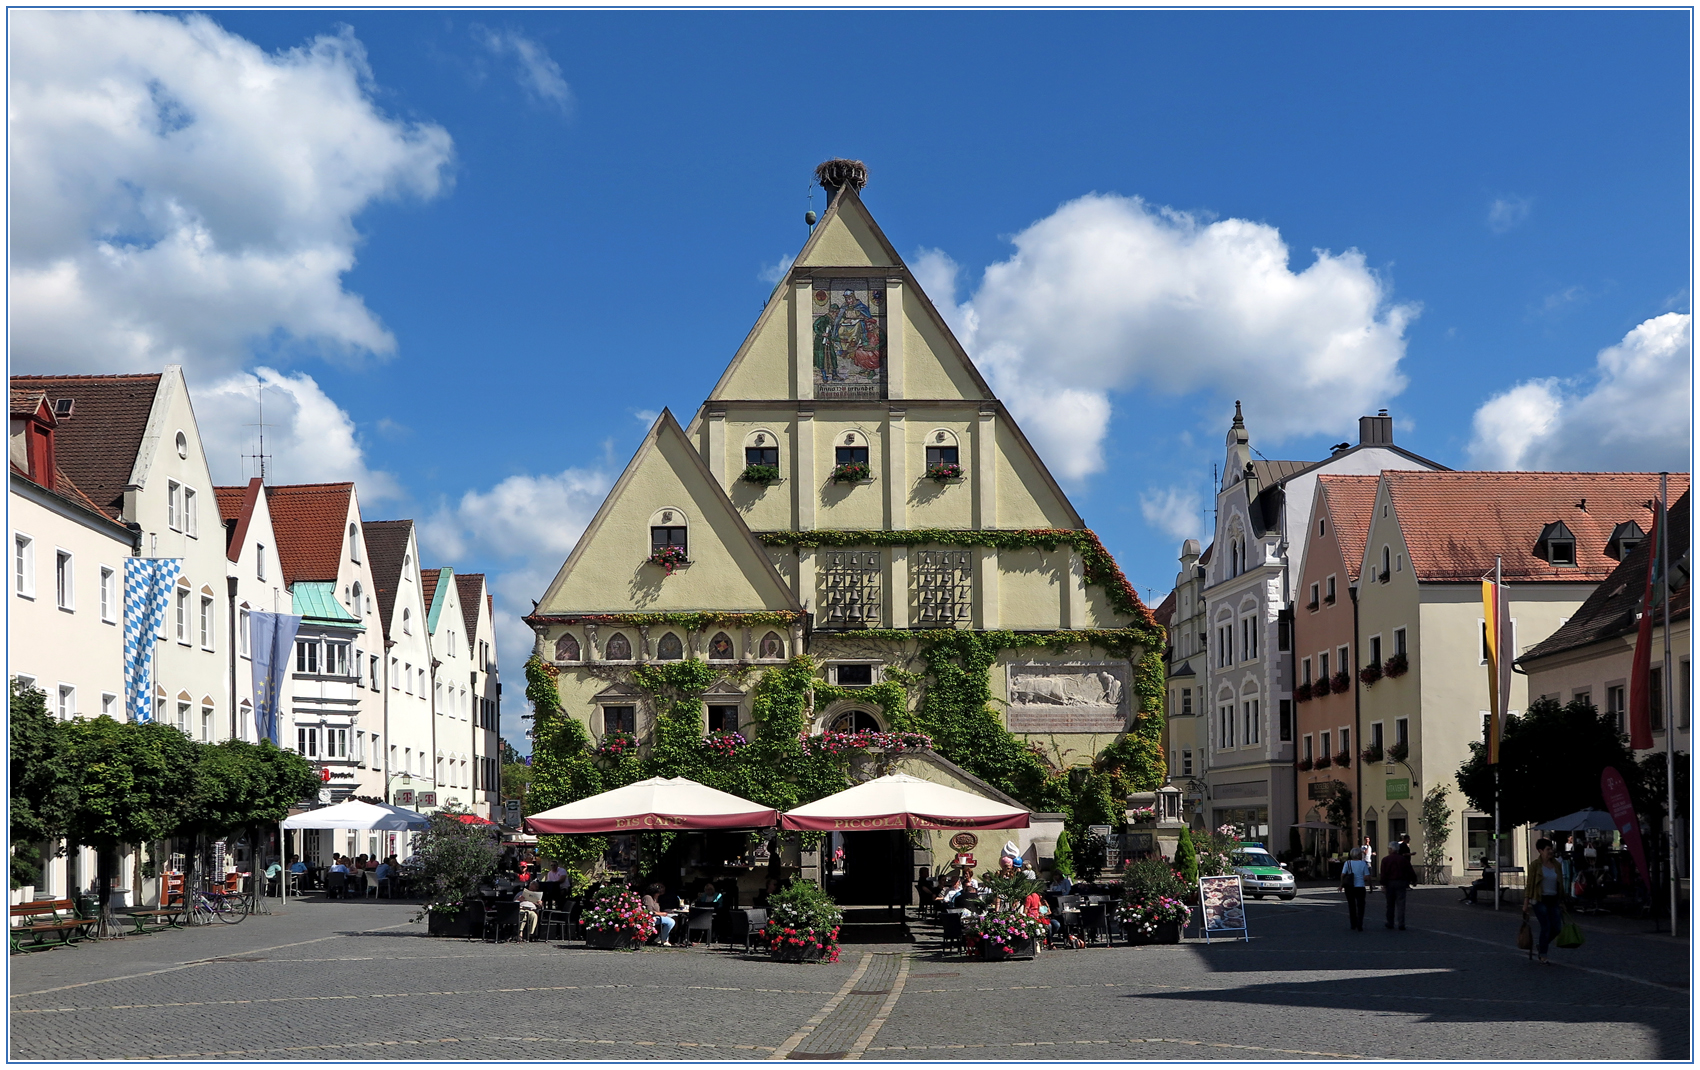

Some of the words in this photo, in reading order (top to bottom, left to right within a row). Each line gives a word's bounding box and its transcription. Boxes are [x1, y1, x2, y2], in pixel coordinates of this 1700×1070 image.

[615, 818, 640, 828] EIS
[834, 816, 904, 828] PICCOLA
[909, 816, 977, 827] VENEZIA
